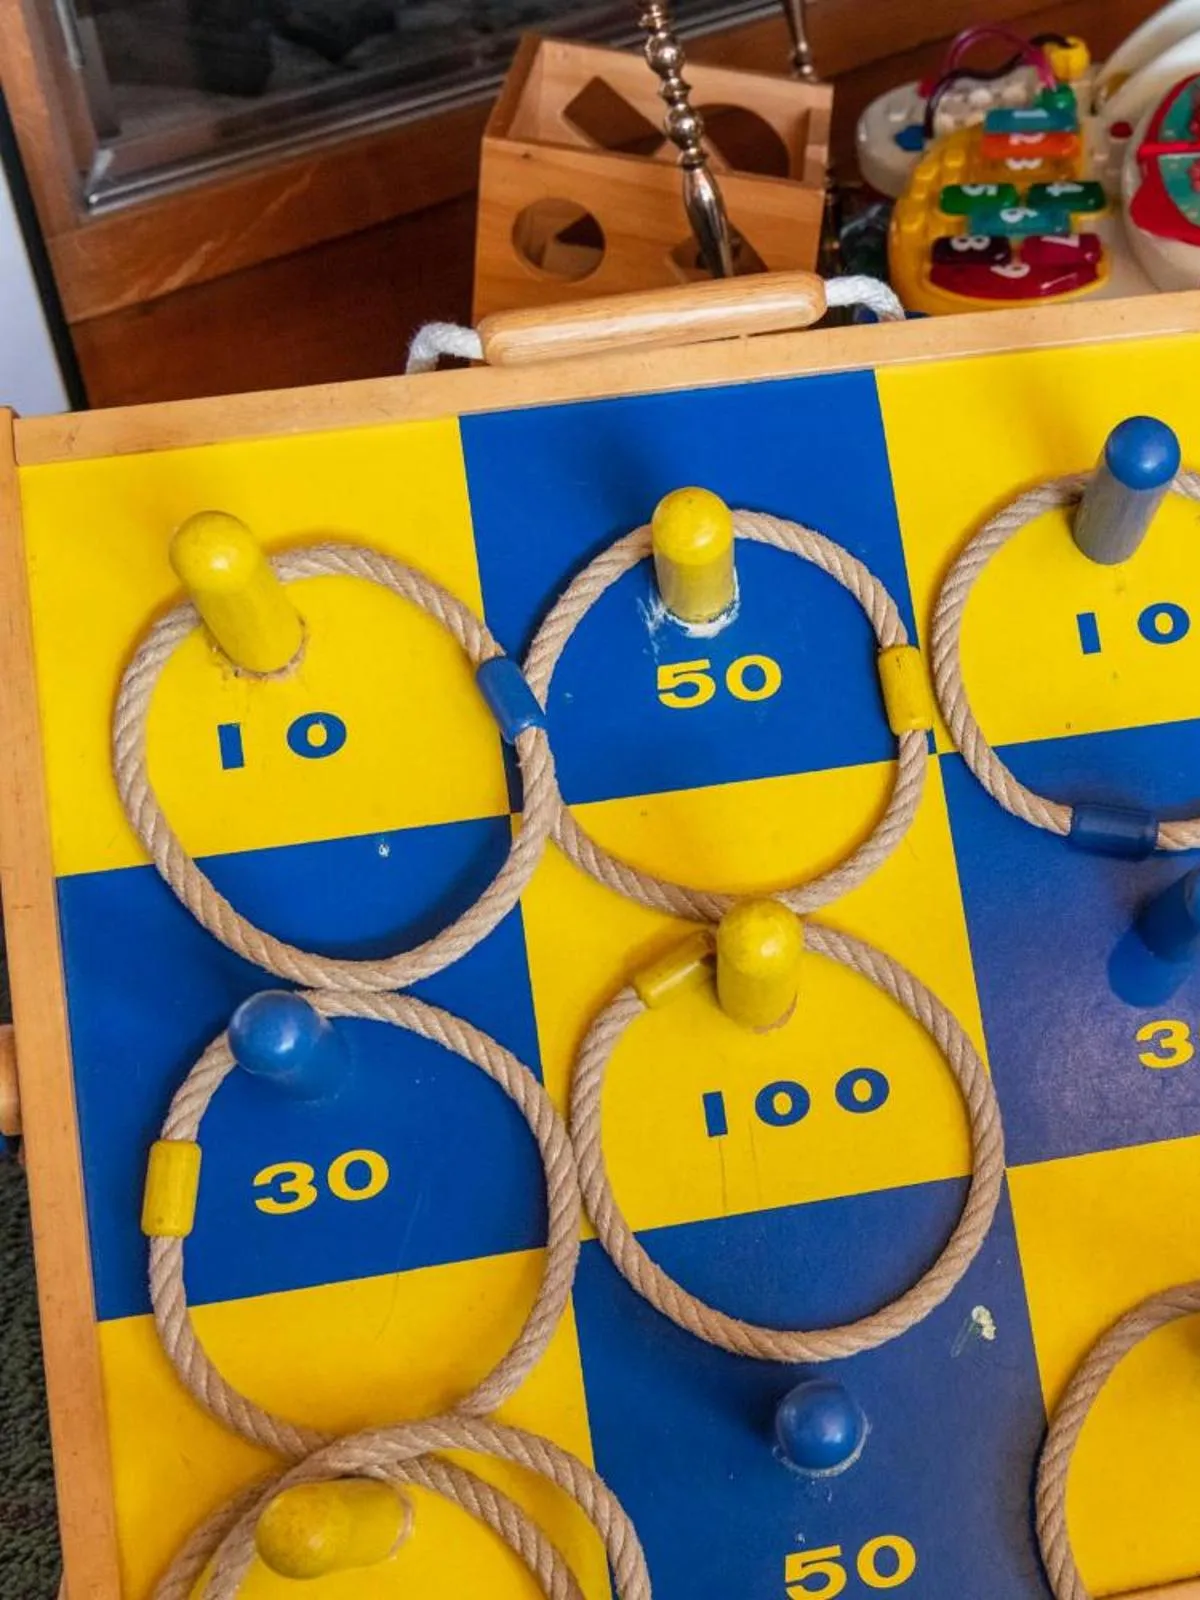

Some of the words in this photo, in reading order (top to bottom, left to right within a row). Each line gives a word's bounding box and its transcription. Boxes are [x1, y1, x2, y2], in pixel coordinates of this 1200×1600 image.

[951, 235, 991, 251] 8
[989, 263, 1031, 279] 9
[1077, 602, 1191, 655] 10
[657, 655, 782, 708] 50
[217, 711, 347, 770] 10
[703, 1067, 890, 1137] 100
[253, 1149, 390, 1214] 30
[784, 1534, 918, 1600] 50
